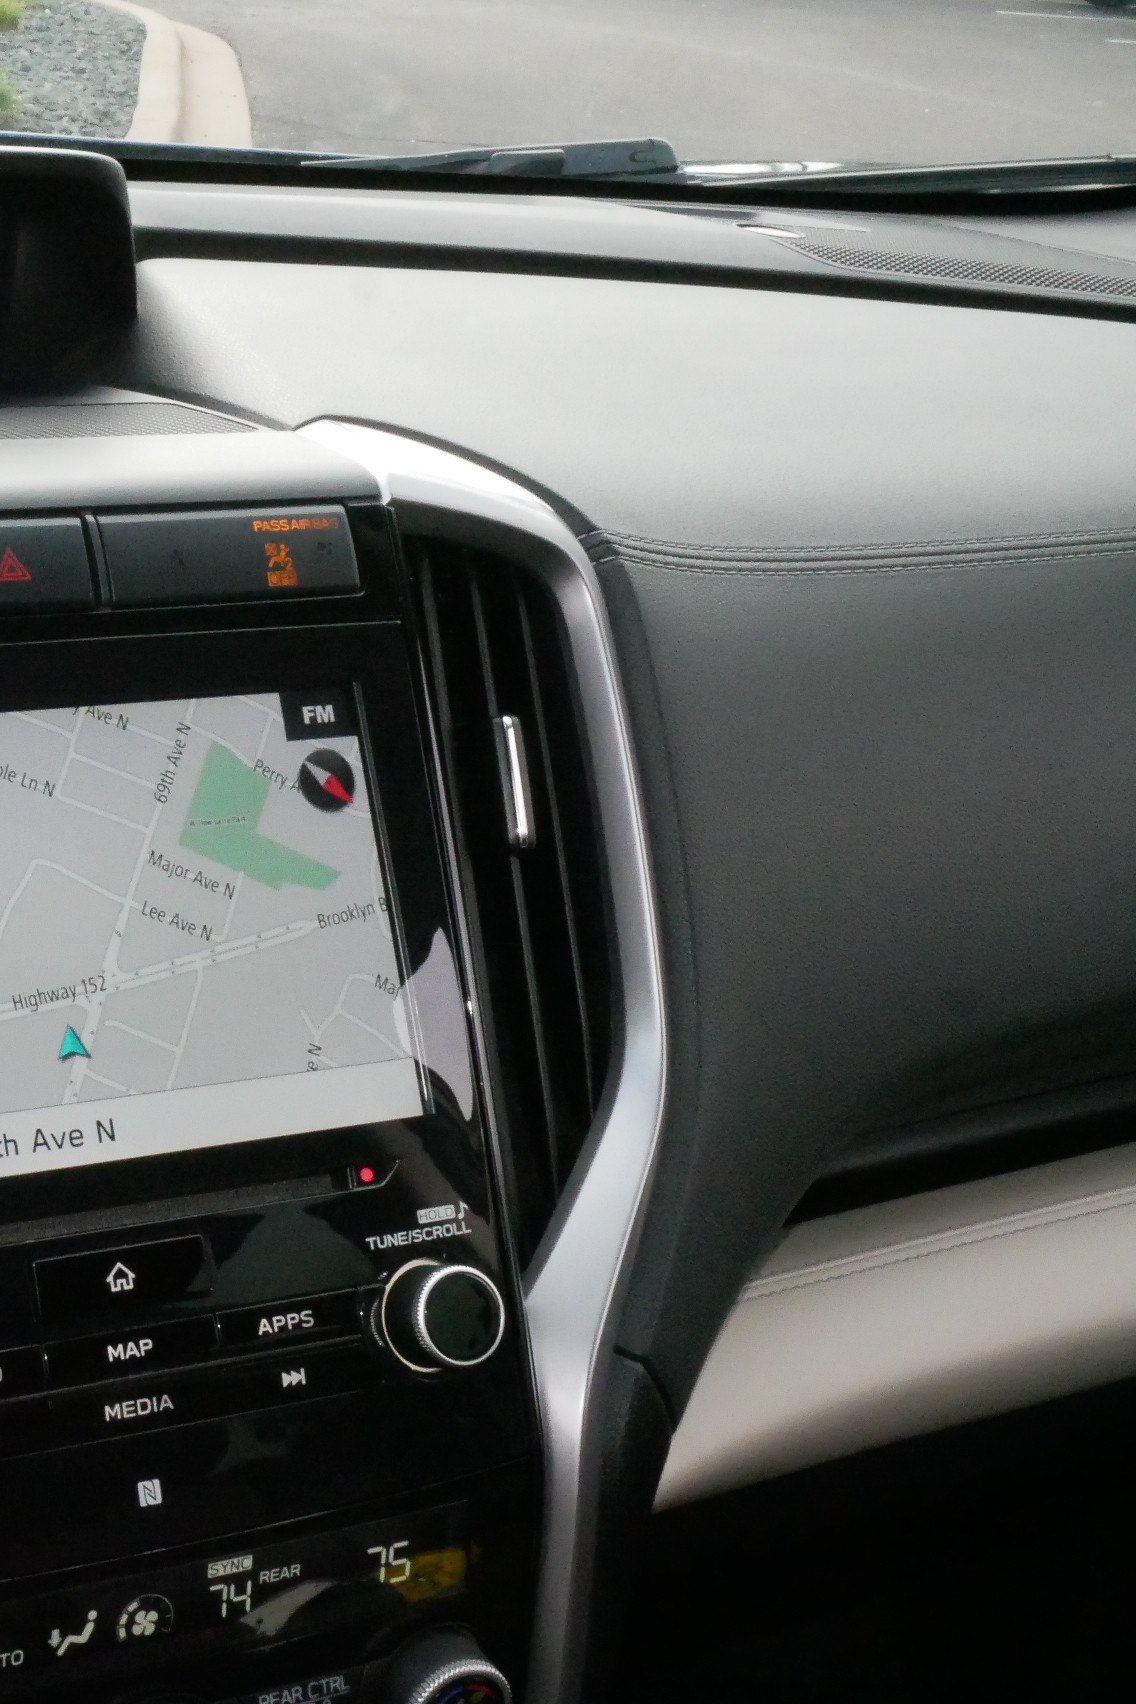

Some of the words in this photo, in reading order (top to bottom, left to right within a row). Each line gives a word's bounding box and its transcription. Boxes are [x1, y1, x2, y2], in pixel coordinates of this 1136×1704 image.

[85, 705, 112, 725] Ave
[116, 713, 129, 730] N
[302, 704, 336, 725] FM
[176, 722, 192, 736] N
[167, 739, 187, 768] Ave
[21, 772, 39, 793] Ln
[42, 780, 57, 798] N
[154, 766, 178, 804] 69th
[253, 758, 288, 791] Perry
[148, 849, 189, 881] Major
[194, 870, 227, 894] Ave
[224, 883, 236, 901] N
[141, 899, 167, 923] Lee
[170, 911, 198, 934] Ave
[201, 926, 214, 942] N
[317, 902, 376, 930] Brooklyn
[12, 983, 78, 1012] Highway
[81, 974, 107, 997] 152
[307, 1043, 322, 1057] N
[32, 1128, 84, 1153] Ave
[96, 1118, 116, 1143] N
[417, 1205, 456, 1223] HOLD
[365, 1221, 472, 1250] TUNE/SCROLL
[258, 1310, 314, 1336] APPS
[107, 1339, 153, 1362] MAP
[104, 1395, 174, 1422] MEDIA
[208, 1555, 253, 1578] SYNC
[259, 1564, 301, 1584] REAR
[368, 1540, 411, 1584] 75
[209, 1580, 252, 1618] 74
[308, 1675, 350, 1699] CTRL
